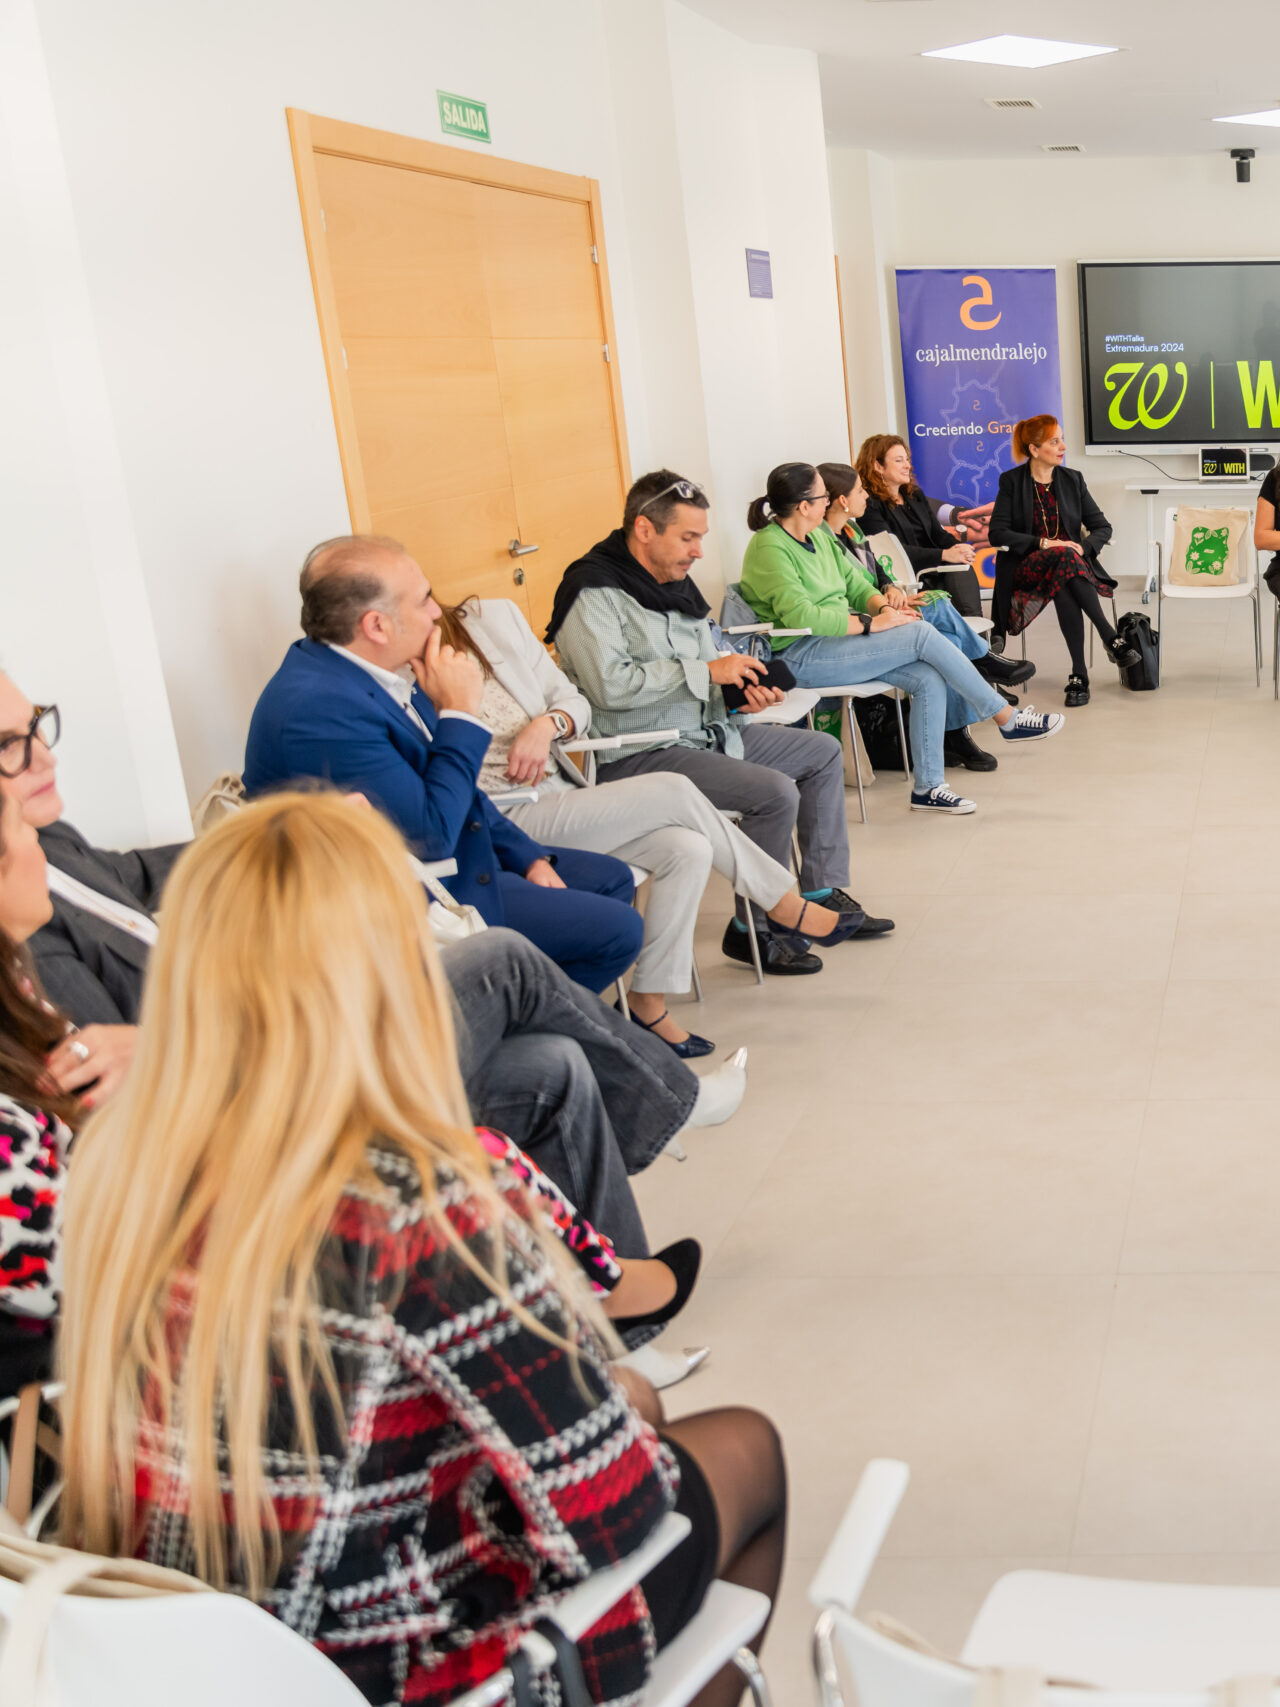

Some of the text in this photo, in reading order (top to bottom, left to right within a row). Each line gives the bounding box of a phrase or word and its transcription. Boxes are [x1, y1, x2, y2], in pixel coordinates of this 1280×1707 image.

[443, 101, 487, 133] SALIDA
[1105, 334, 1145, 342] #WITHTalks
[1105, 343, 1184, 352] Extremadura 2024
[915, 343, 1047, 367] cajalmendralejo
[914, 422, 983, 437] Creciendo
[1223, 462, 1246, 474] WITH
